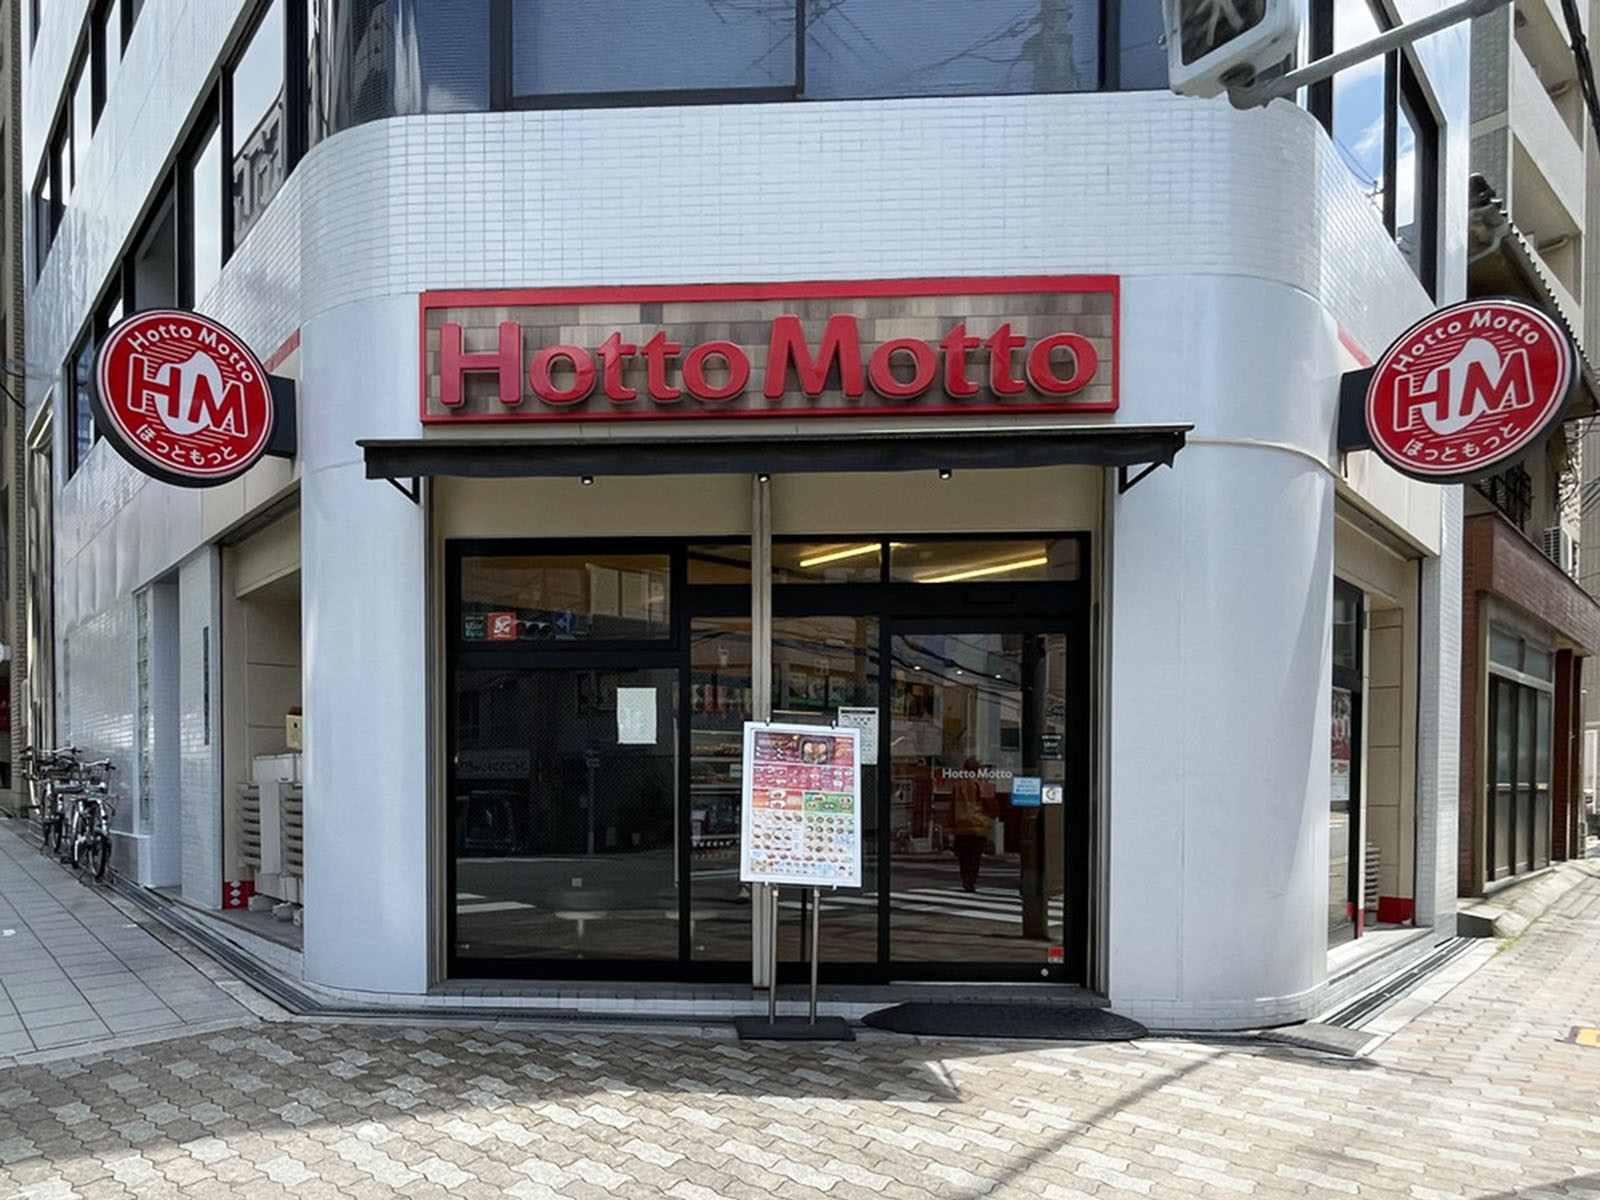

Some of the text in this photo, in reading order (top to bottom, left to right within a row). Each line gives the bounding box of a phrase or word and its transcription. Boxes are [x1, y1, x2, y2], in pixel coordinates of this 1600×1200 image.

[127, 324, 253, 384] Hotto Motto
[439, 312, 1100, 406] Hotto Motto
[1392, 310, 1539, 372] Hotto Motto
[136, 423, 238, 465] ほっともっと
[1402, 422, 1520, 462] ほっともっと
[942, 768, 1013, 779] Hotto Motto
